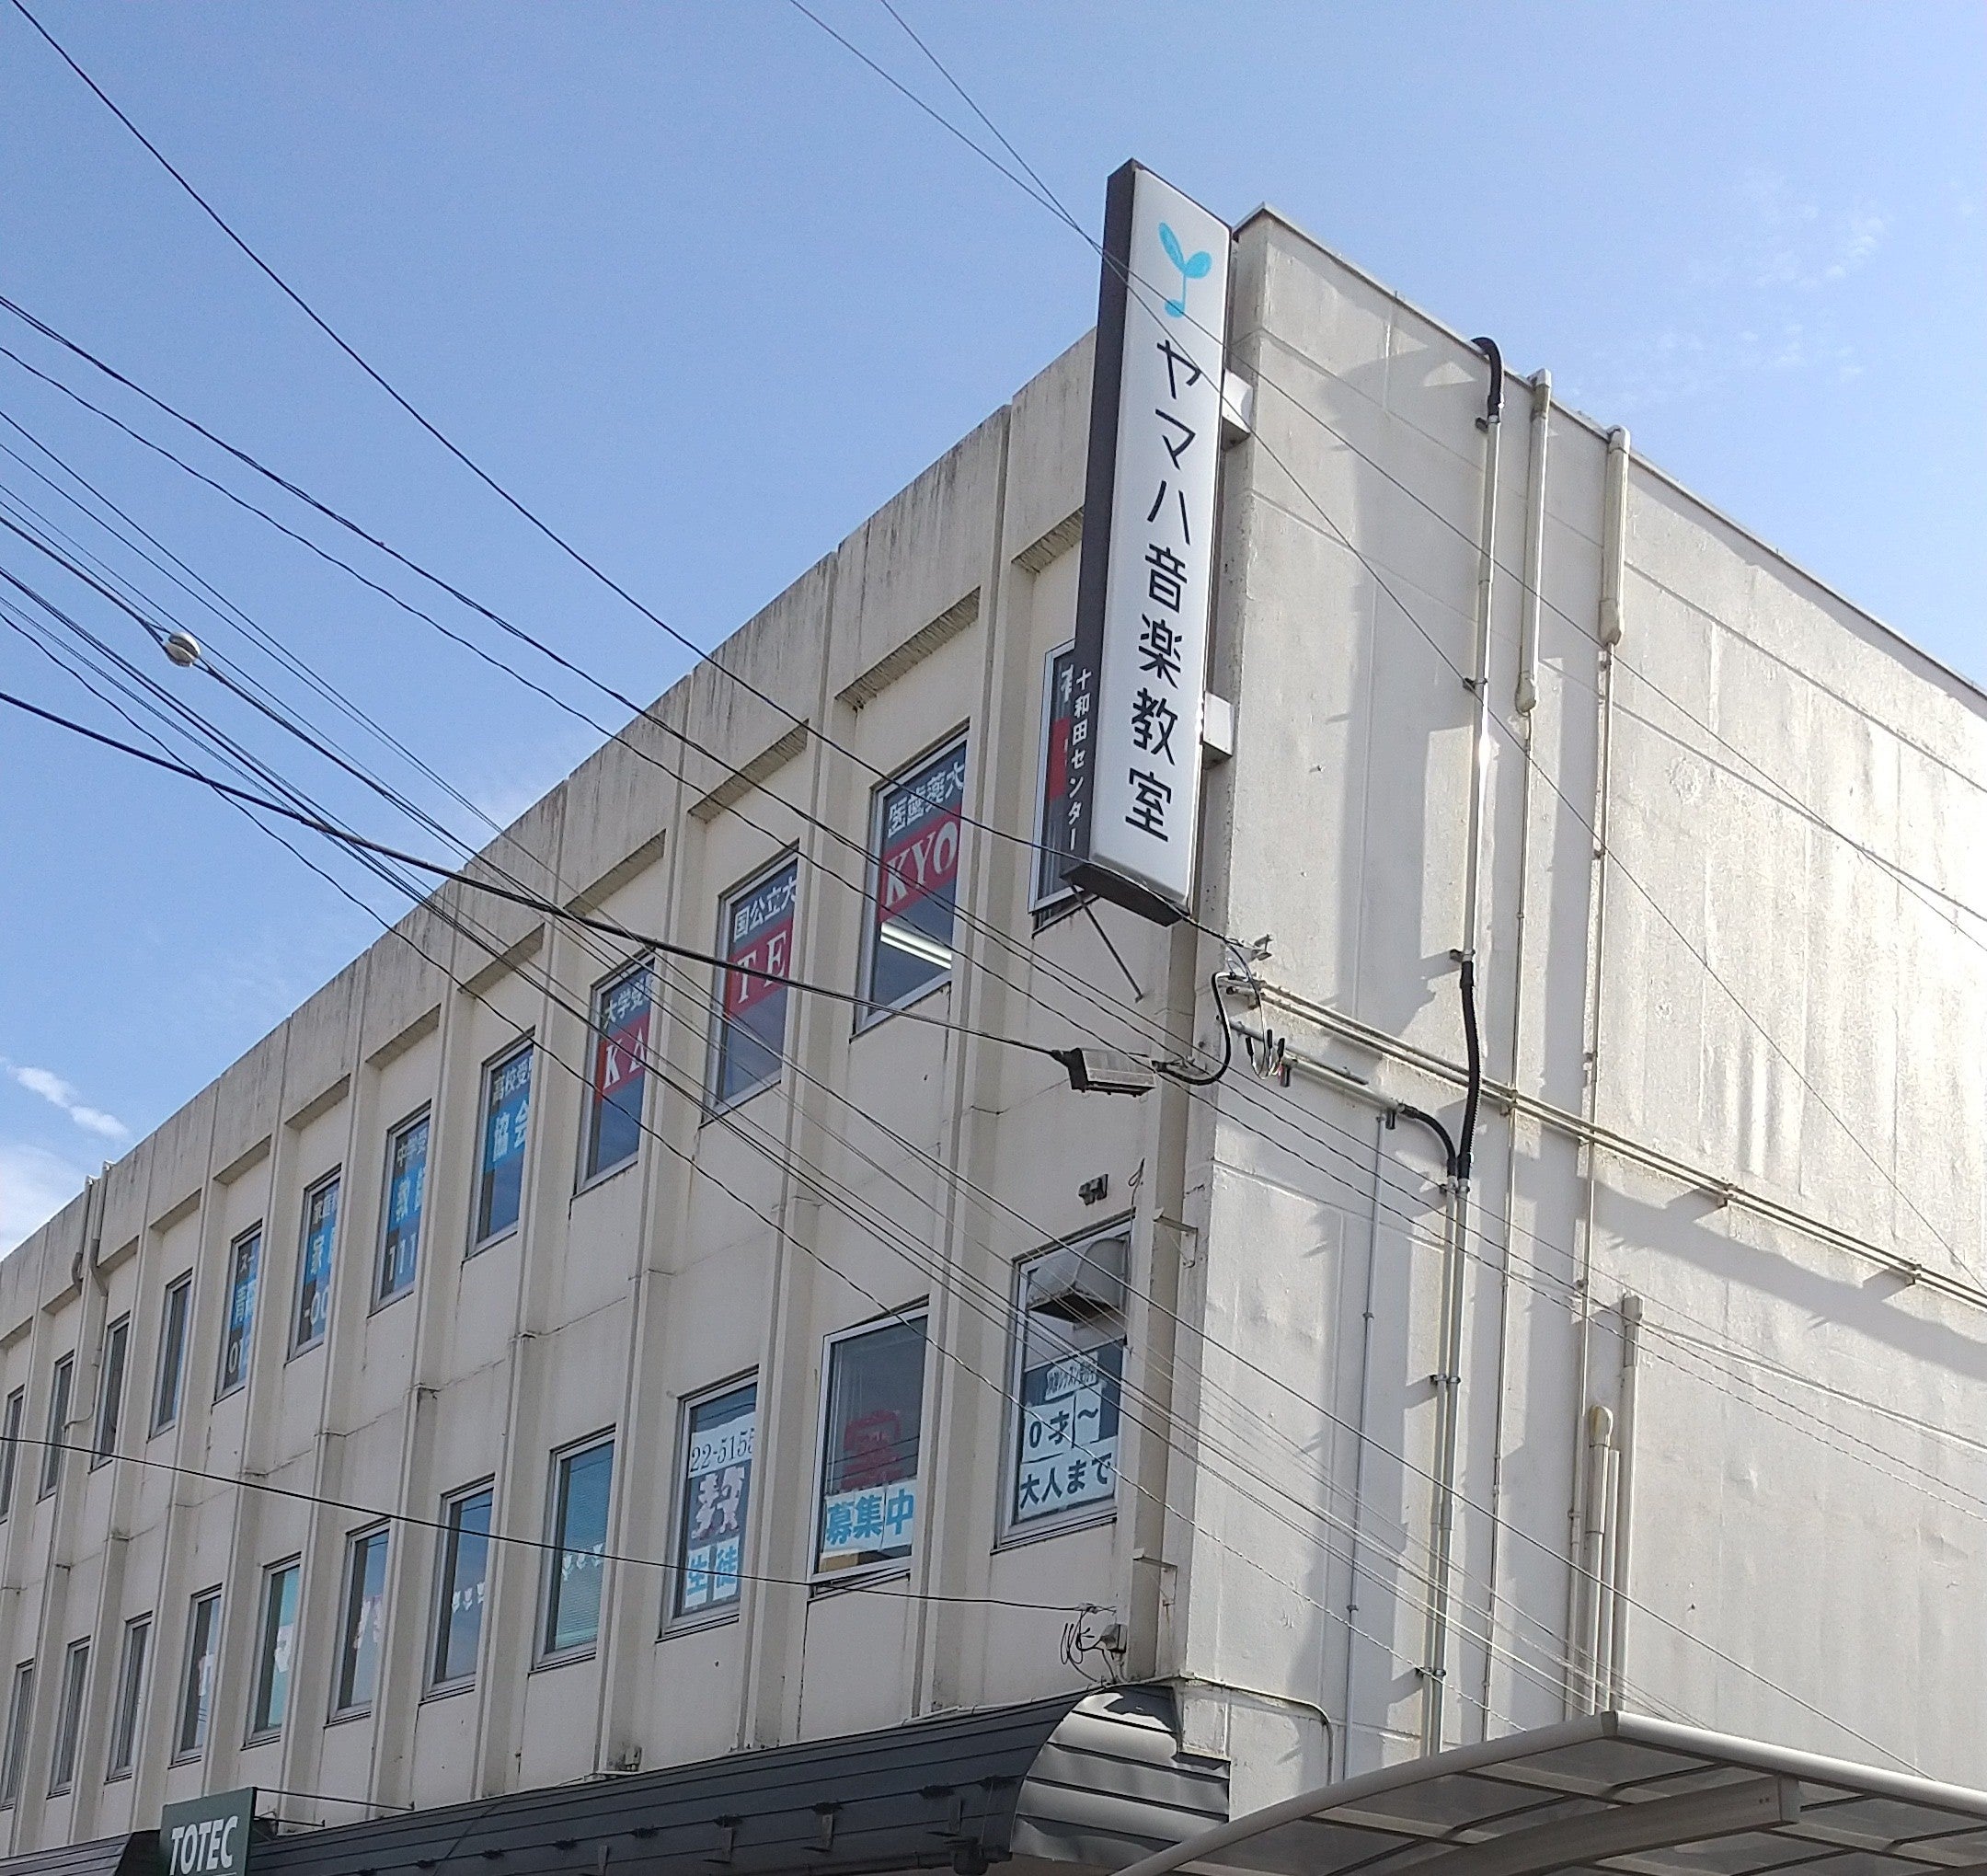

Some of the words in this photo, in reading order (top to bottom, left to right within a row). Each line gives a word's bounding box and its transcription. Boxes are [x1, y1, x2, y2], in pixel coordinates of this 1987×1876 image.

[1126, 339, 1201, 843] ヤマハ音楽教室
[1069, 666, 1093, 852] 十和田センター
[884, 822, 959, 907] KYO
[733, 875, 798, 943] 国公立大
[1019, 1452, 1112, 1510] 大人まで
[827, 1488, 914, 1546] 募集中
[687, 1545, 738, 1595] 生徒
[169, 1815, 238, 1876] TOTEC
